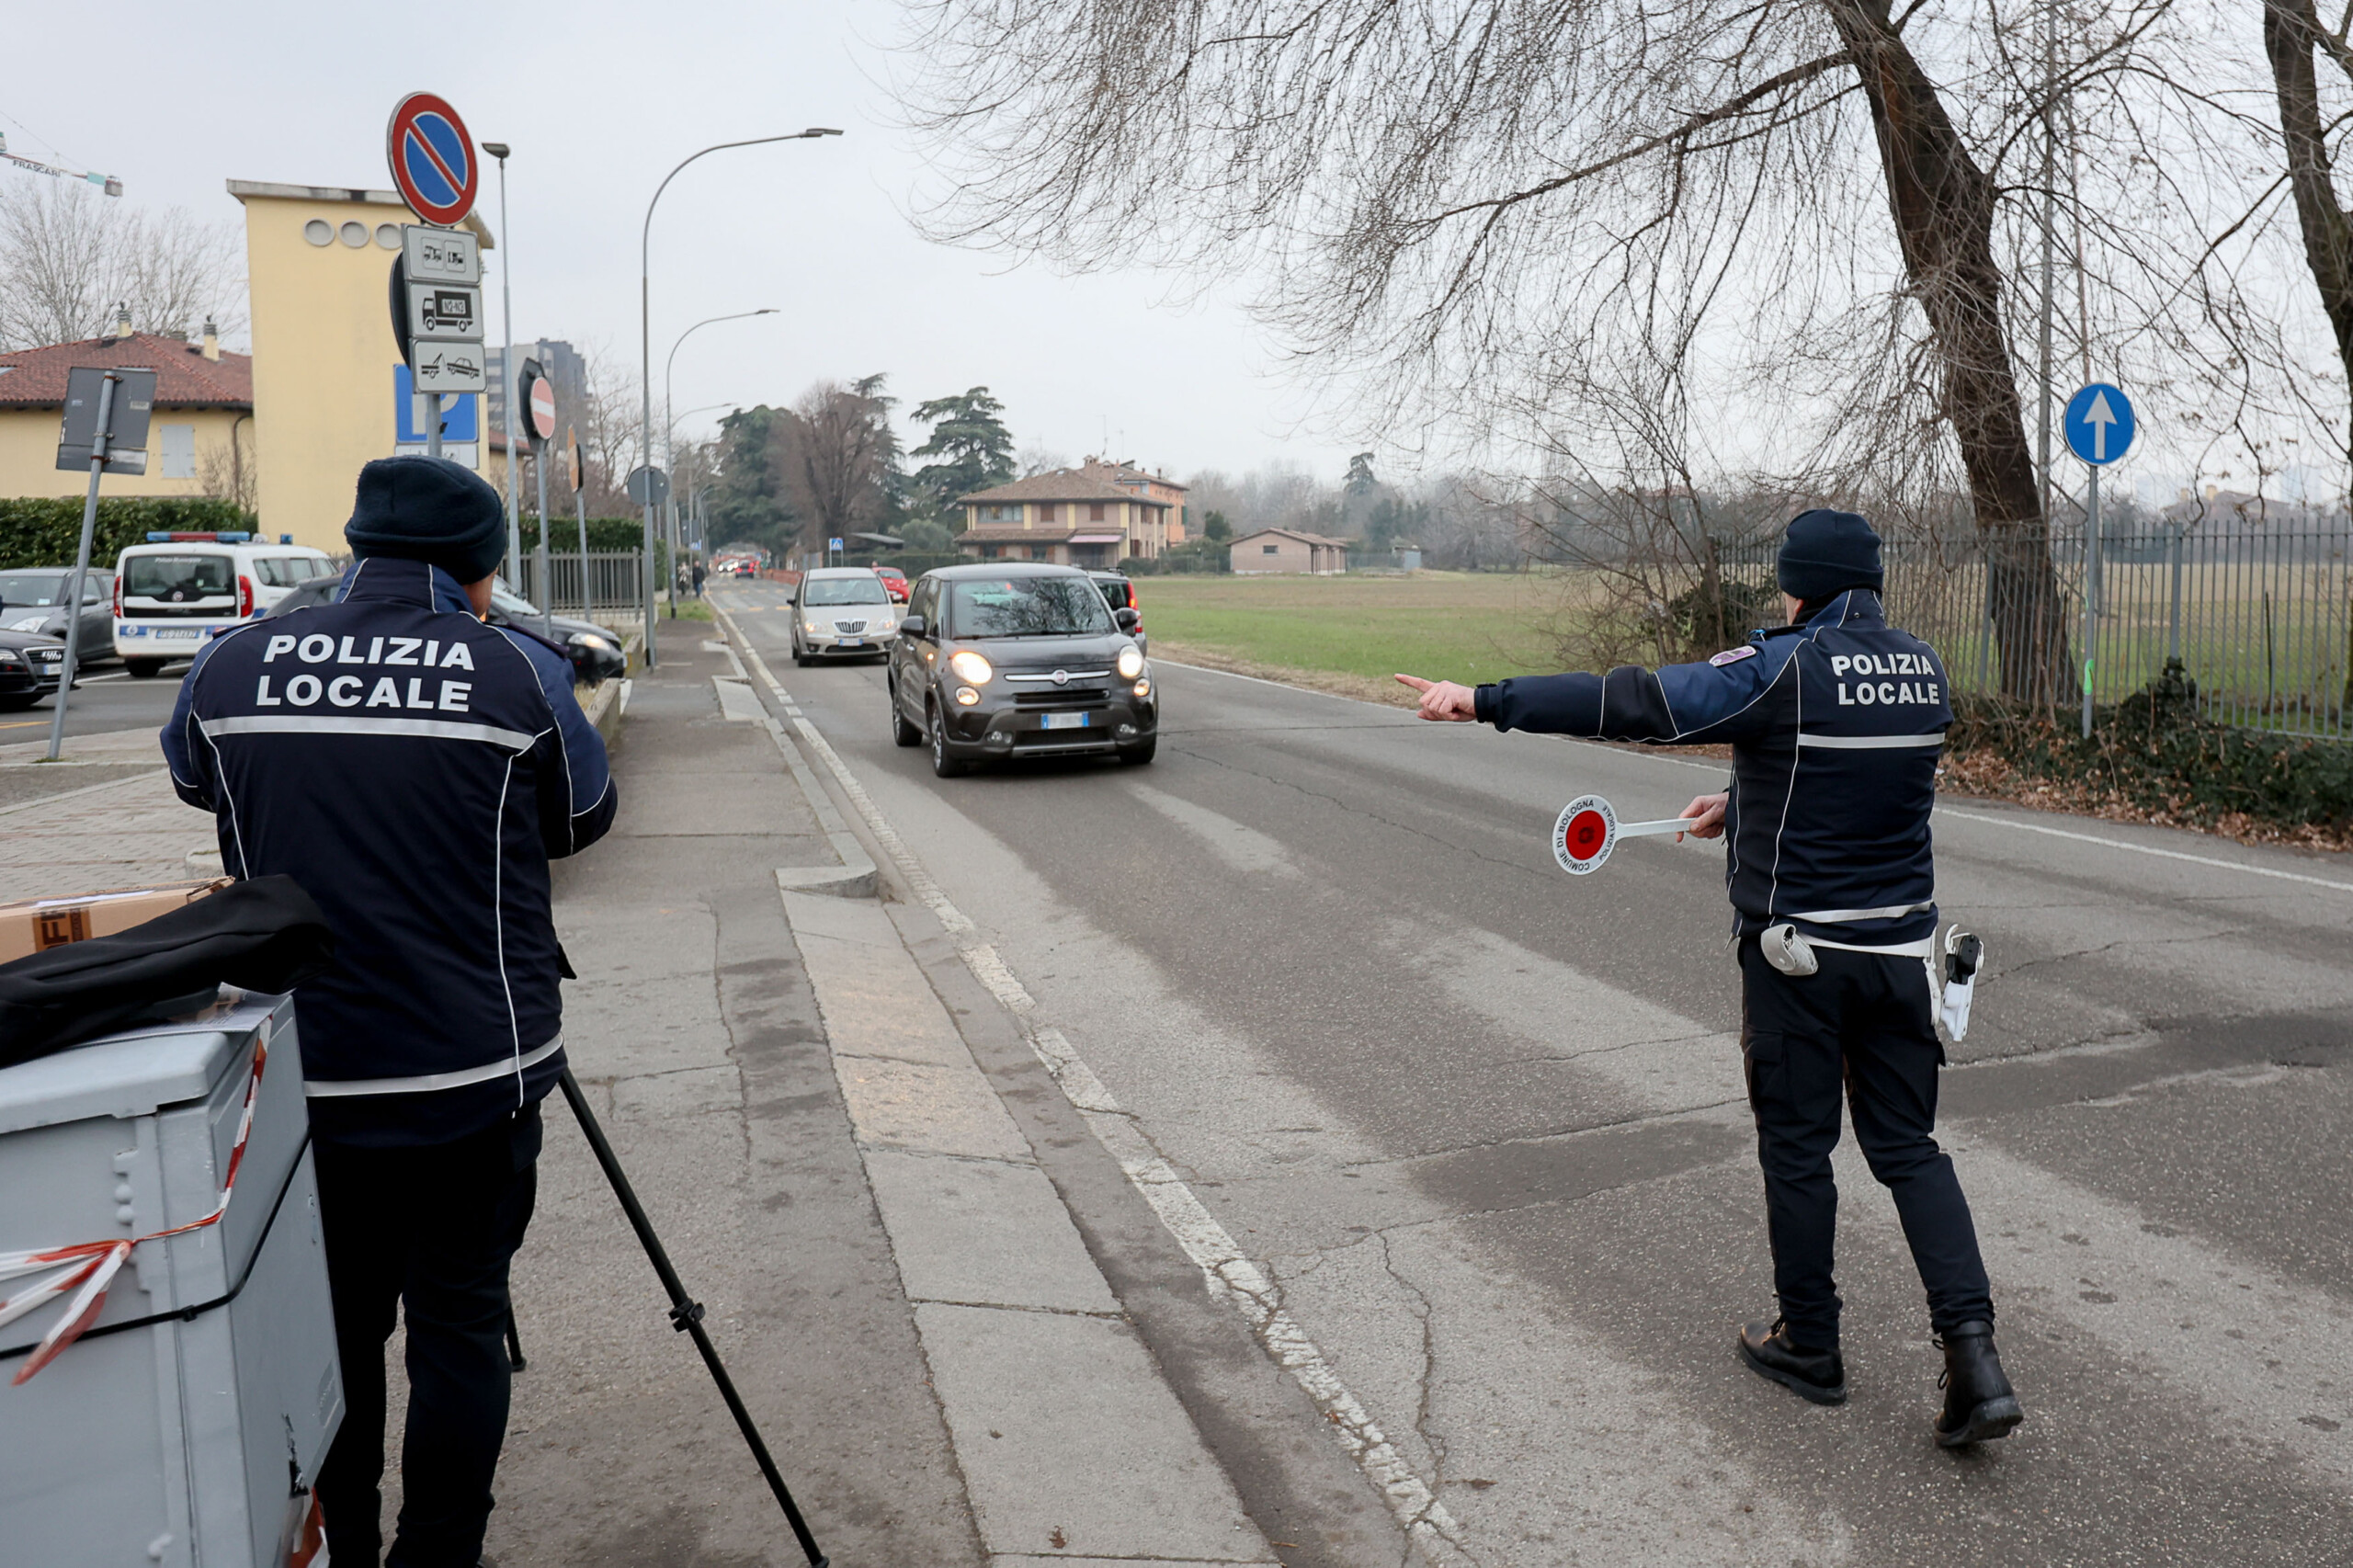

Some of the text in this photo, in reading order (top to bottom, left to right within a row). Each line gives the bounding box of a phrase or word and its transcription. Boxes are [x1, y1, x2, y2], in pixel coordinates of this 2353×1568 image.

[13, 160, 61, 177] FRASCARI
[263, 634, 474, 671] POLIZIA
[1830, 653, 1936, 676] POLIZIA
[256, 674, 472, 713] LOCALE
[1837, 682, 1940, 705] LOCALE
[1557, 800, 1594, 871] COMUNE DI BOLOGNA
[1598, 804, 1616, 860] POLIZIA LOCALE
